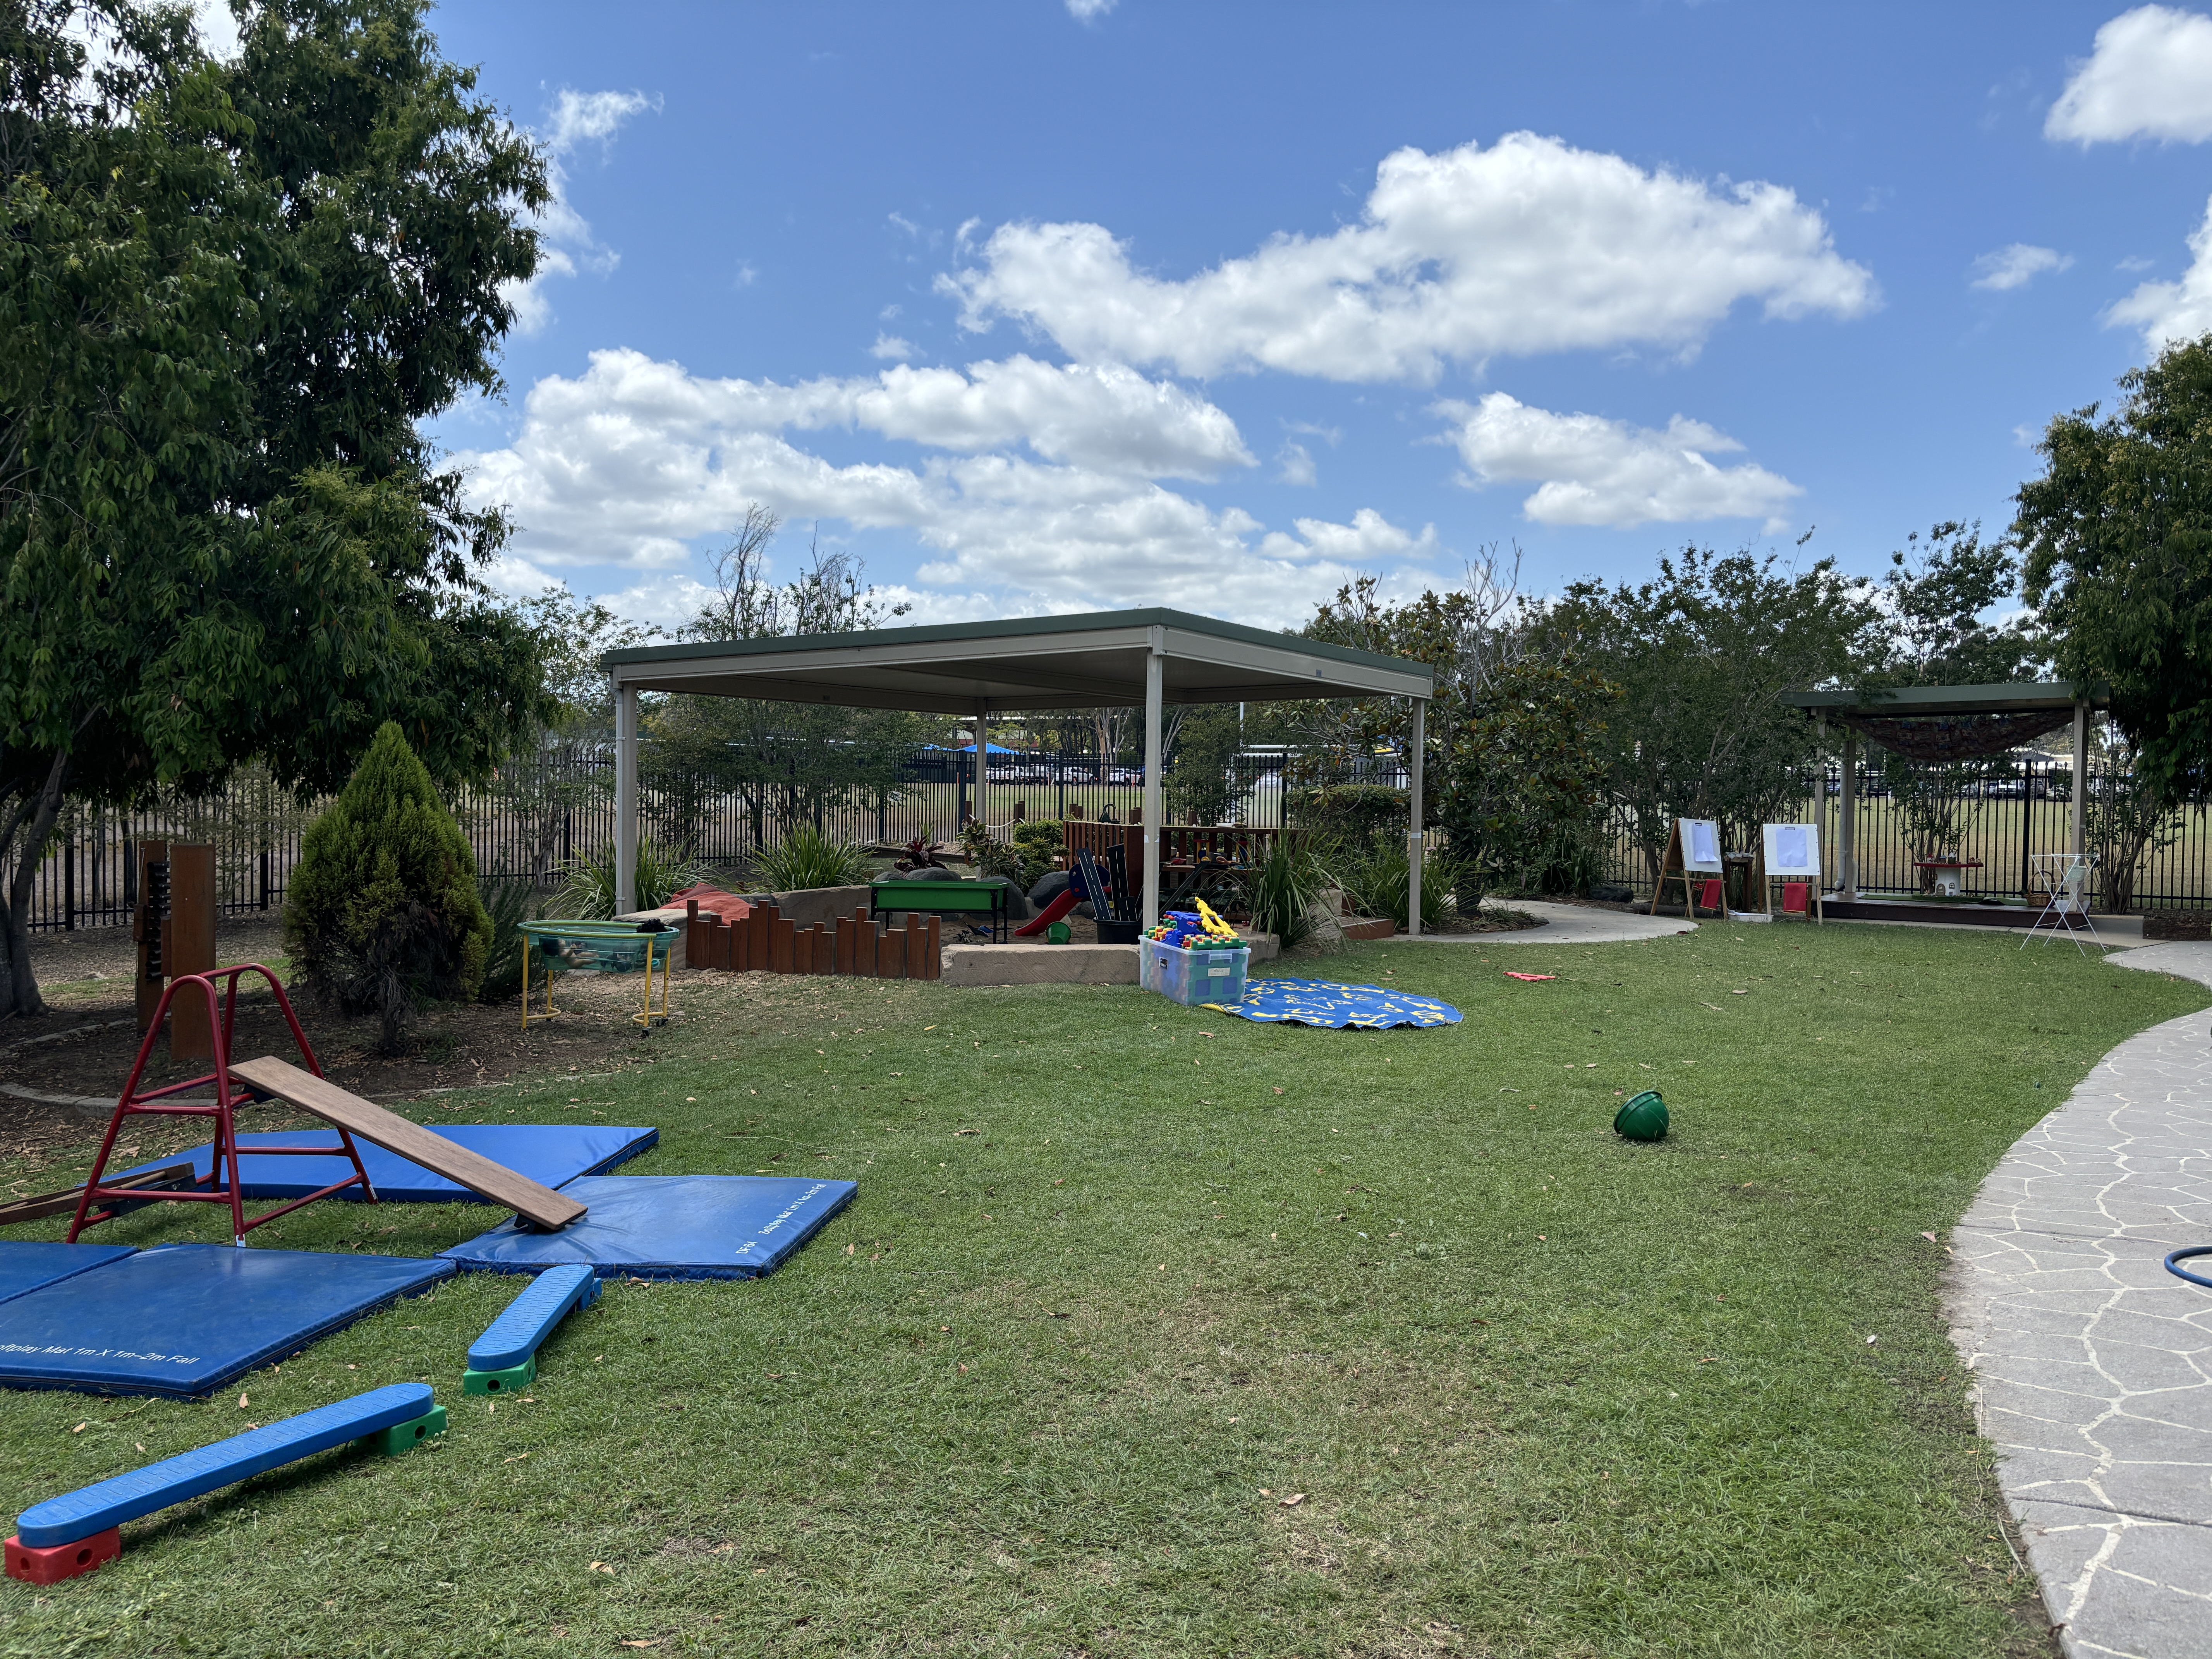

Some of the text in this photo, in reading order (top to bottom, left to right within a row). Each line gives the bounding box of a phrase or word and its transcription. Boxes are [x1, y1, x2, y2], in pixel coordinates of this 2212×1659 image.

[758, 1218, 786, 1234] Softplay
[41, 1346, 74, 1354] Mat
[113, 1350, 166, 1361] 1m-2m
[166, 1355, 200, 1364] Fall
